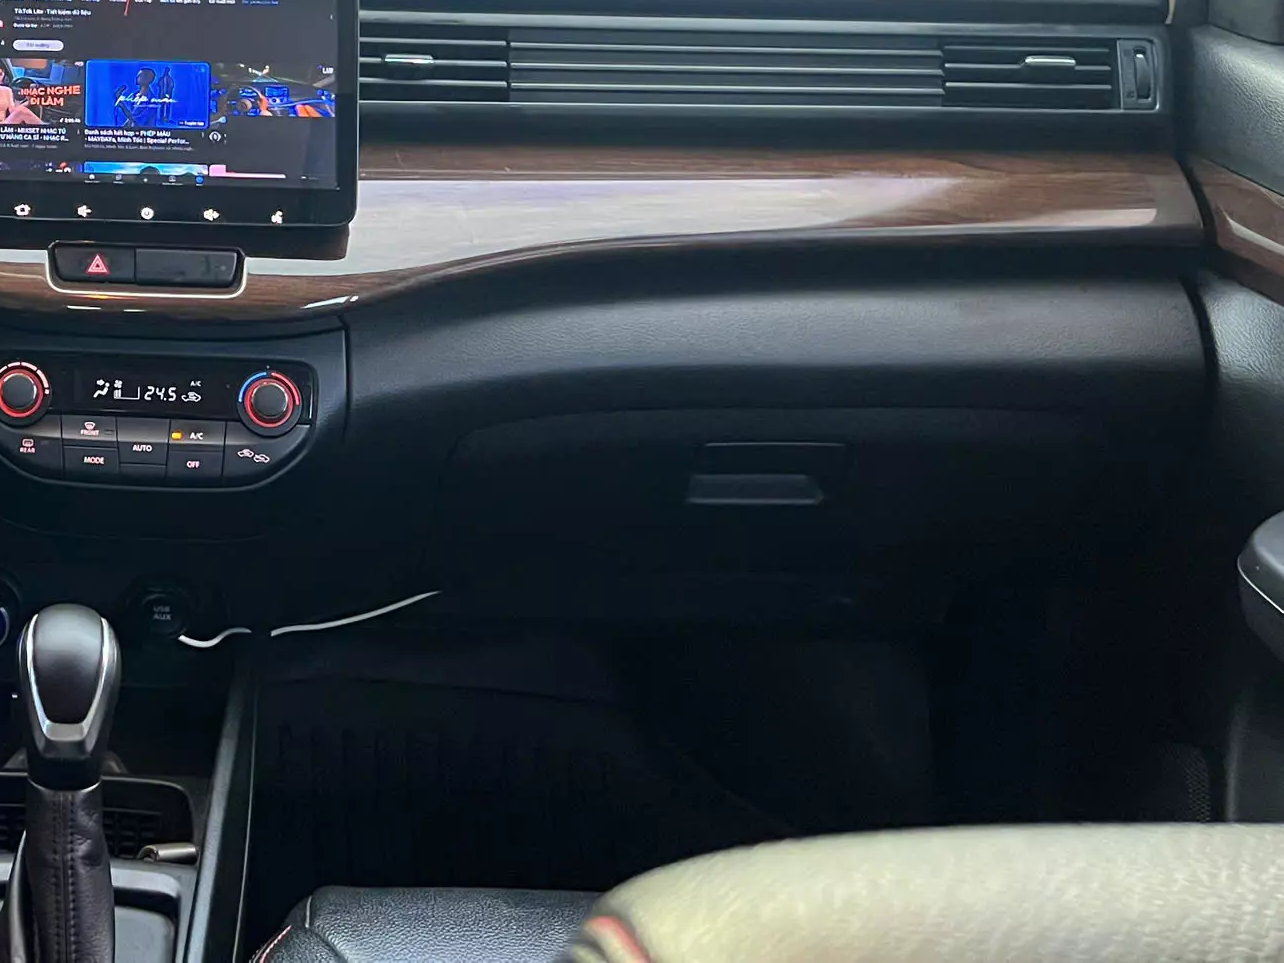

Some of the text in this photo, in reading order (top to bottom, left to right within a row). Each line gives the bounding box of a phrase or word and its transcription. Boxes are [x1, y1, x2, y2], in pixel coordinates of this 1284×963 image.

[20, 85, 81, 97] NHẠC NGHE
[144, 386, 177, 401] 24.5
[80, 428, 99, 436] FRONT
[189, 432, 204, 441] A/C
[19, 445, 36, 454] REAR
[132, 444, 153, 453] AUTO
[83, 455, 105, 465] MODE
[186, 460, 200, 469] OFF
[152, 613, 172, 621] AUX
